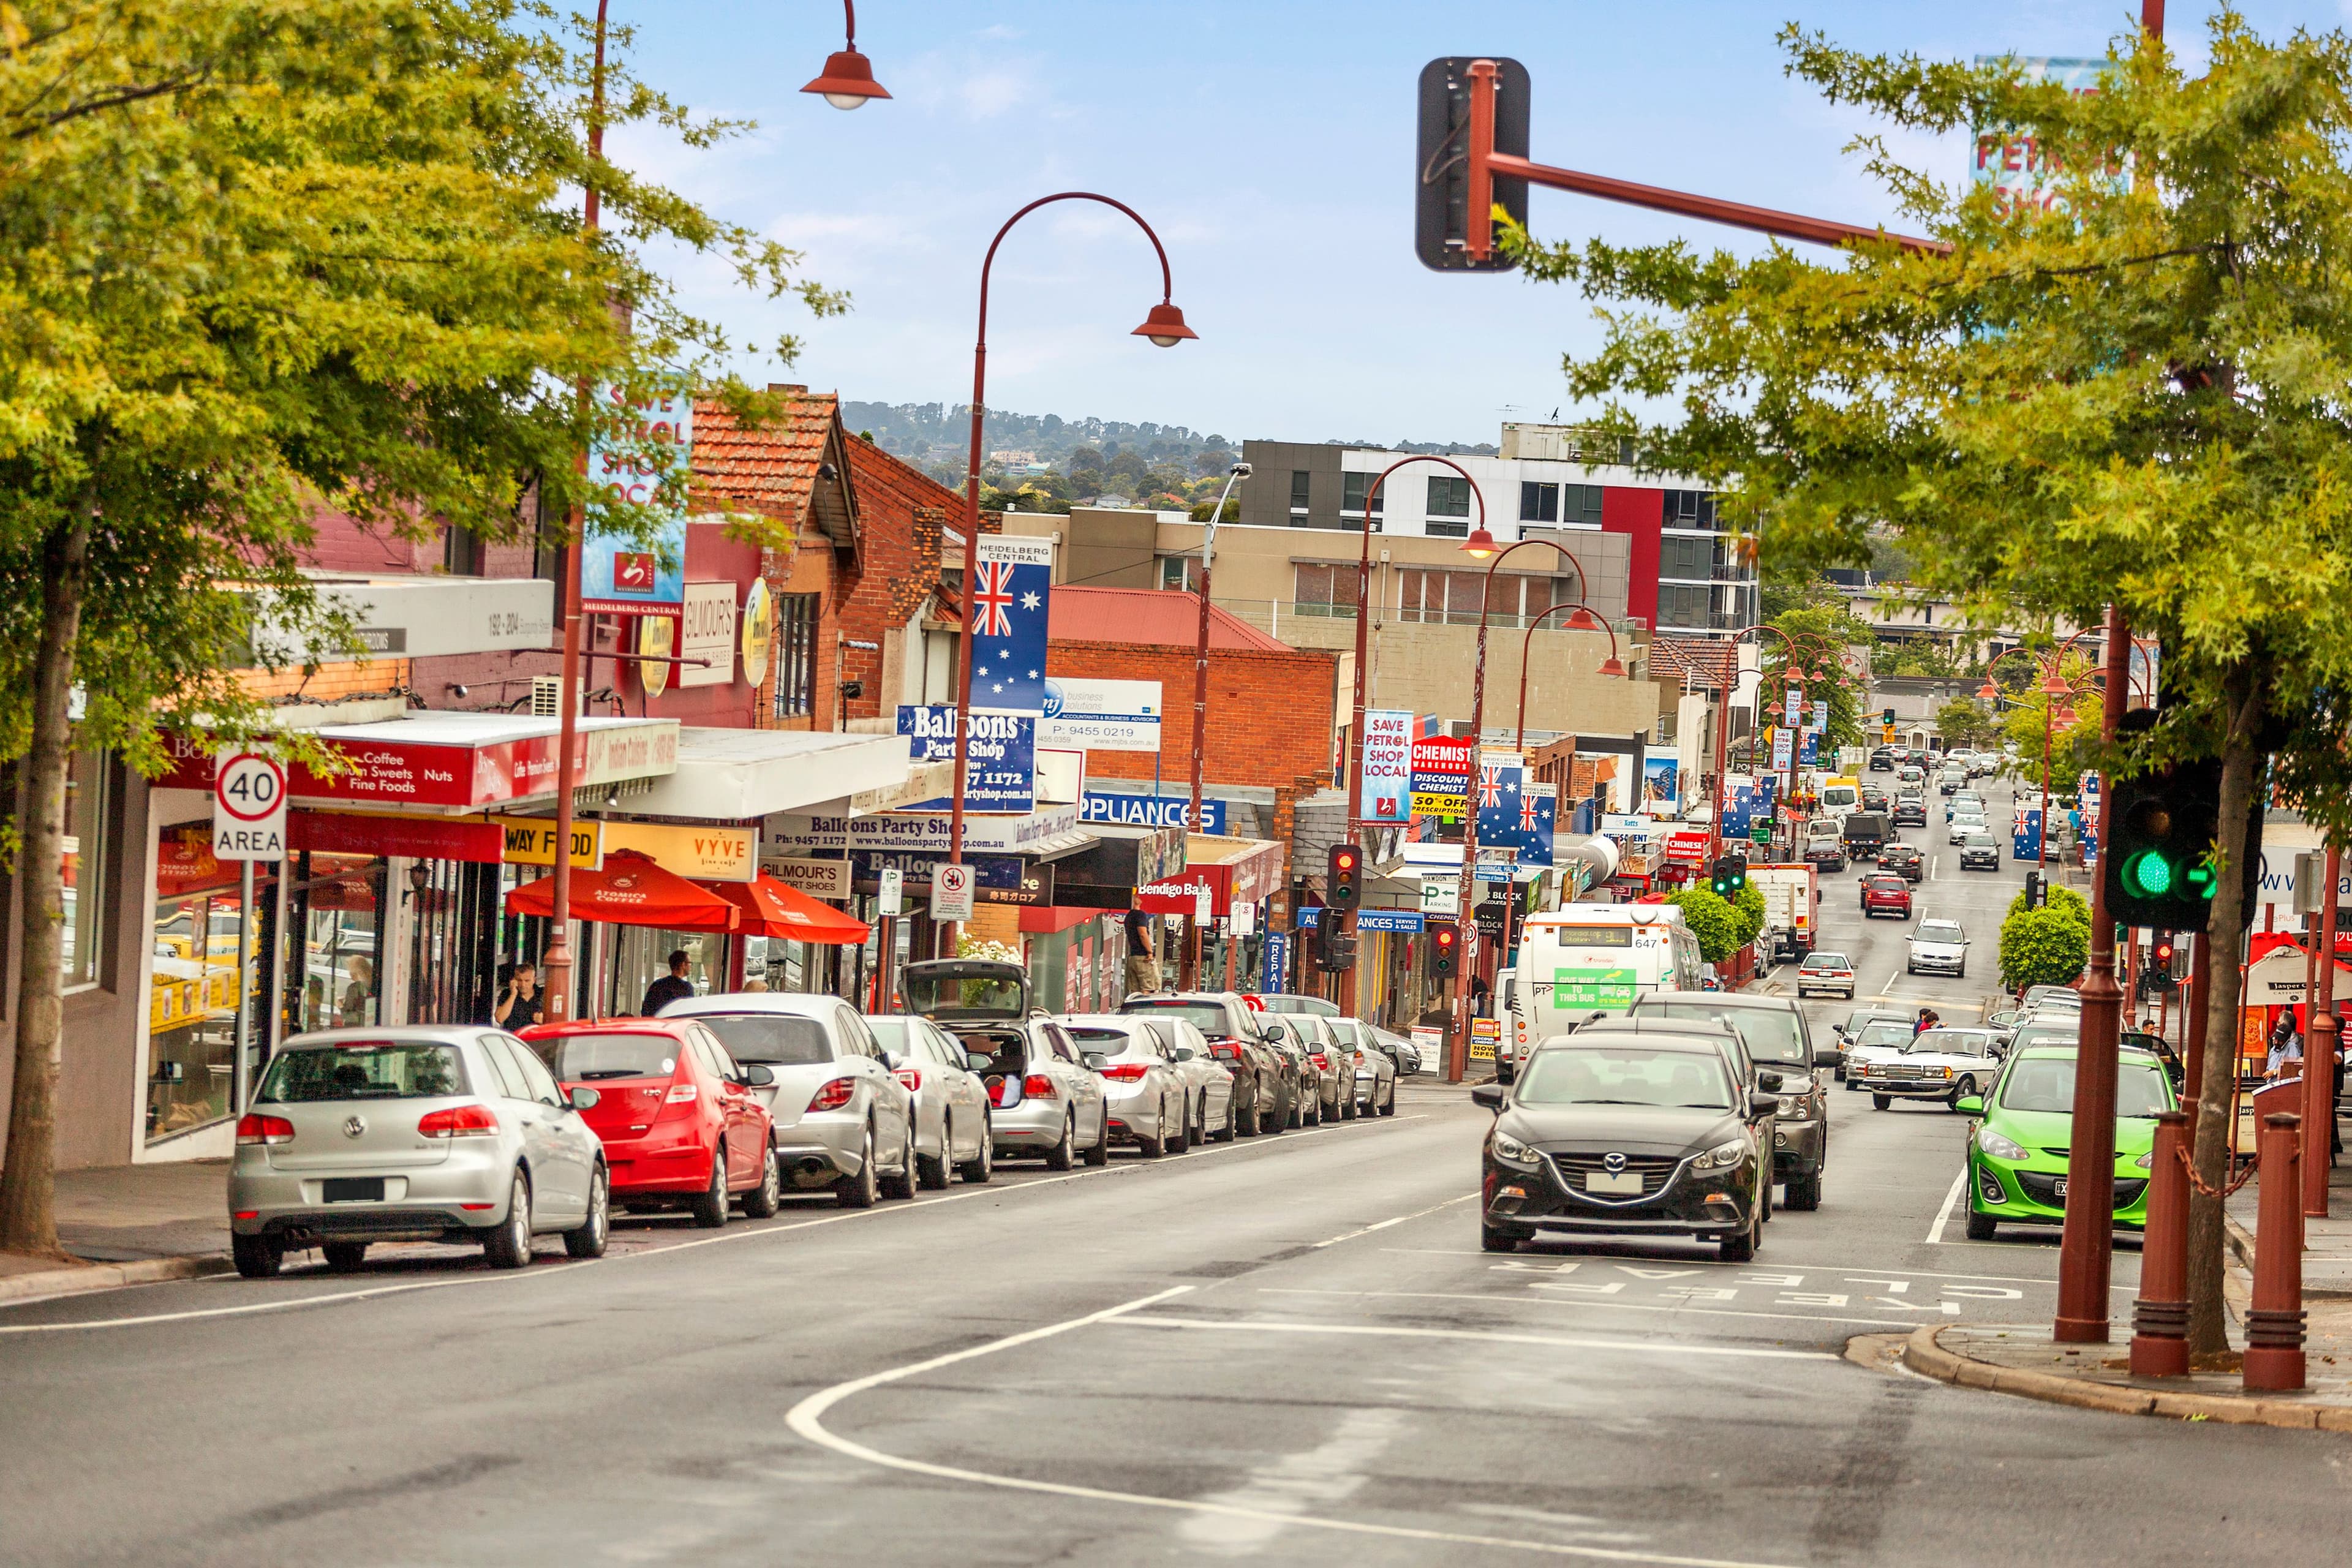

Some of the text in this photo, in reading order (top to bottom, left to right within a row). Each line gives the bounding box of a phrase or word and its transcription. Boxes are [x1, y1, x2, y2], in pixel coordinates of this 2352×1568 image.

[981, 545, 1049, 555] HEIDELBERG
[989, 553, 1039, 562] CENTRAL
[584, 603, 680, 614] HEIDELBERG CENTRAL
[489, 612, 518, 636] 192 204
[685, 598, 732, 639] GILMOUR'S
[1067, 691, 1103, 701] business
[1065, 701, 1102, 711] solutions
[1372, 719, 1404, 731] SAVE
[1053, 726, 1134, 737] P: 9455 0219
[1366, 734, 1409, 747] PETROL
[925, 740, 1005, 760] Part Shop
[1370, 750, 1404, 762] SHOP
[1413, 745, 1471, 762] CHEMIST
[364, 752, 404, 766] Coffee
[1365, 765, 1408, 777] LOCAL
[1413, 761, 1467, 771] WAREHOUS
[371, 767, 413, 780] Sweets
[424, 769, 453, 782] Nuts
[984, 772, 1022, 785] 1172
[1414, 774, 1469, 784] DISCOUNT
[229, 773, 274, 802] 40
[350, 778, 416, 794] Fine Foods
[1419, 783, 1466, 793] CHEMIST
[1444, 798, 1468, 807] OFF
[812, 816, 878, 834] Balloons
[881, 818, 924, 835] Party
[218, 831, 281, 851] AREA
[506, 828, 592, 856] WAY FOD
[775, 834, 792, 844] Ph:
[796, 836, 820, 845] 9457
[1669, 840, 1703, 850] CHINESE
[695, 839, 745, 858] VYVE
[761, 864, 837, 880] GILMOUR'S
[886, 871, 897, 883] 1P
[805, 881, 836, 891] SHOES
[1138, 882, 1183, 898] Bendigo
[595, 889, 647, 899] ATOMICA
[1477, 920, 1503, 929] BLOCK
[1635, 939, 1657, 948] 647
[1559, 993, 1595, 1002] THIS BUS
